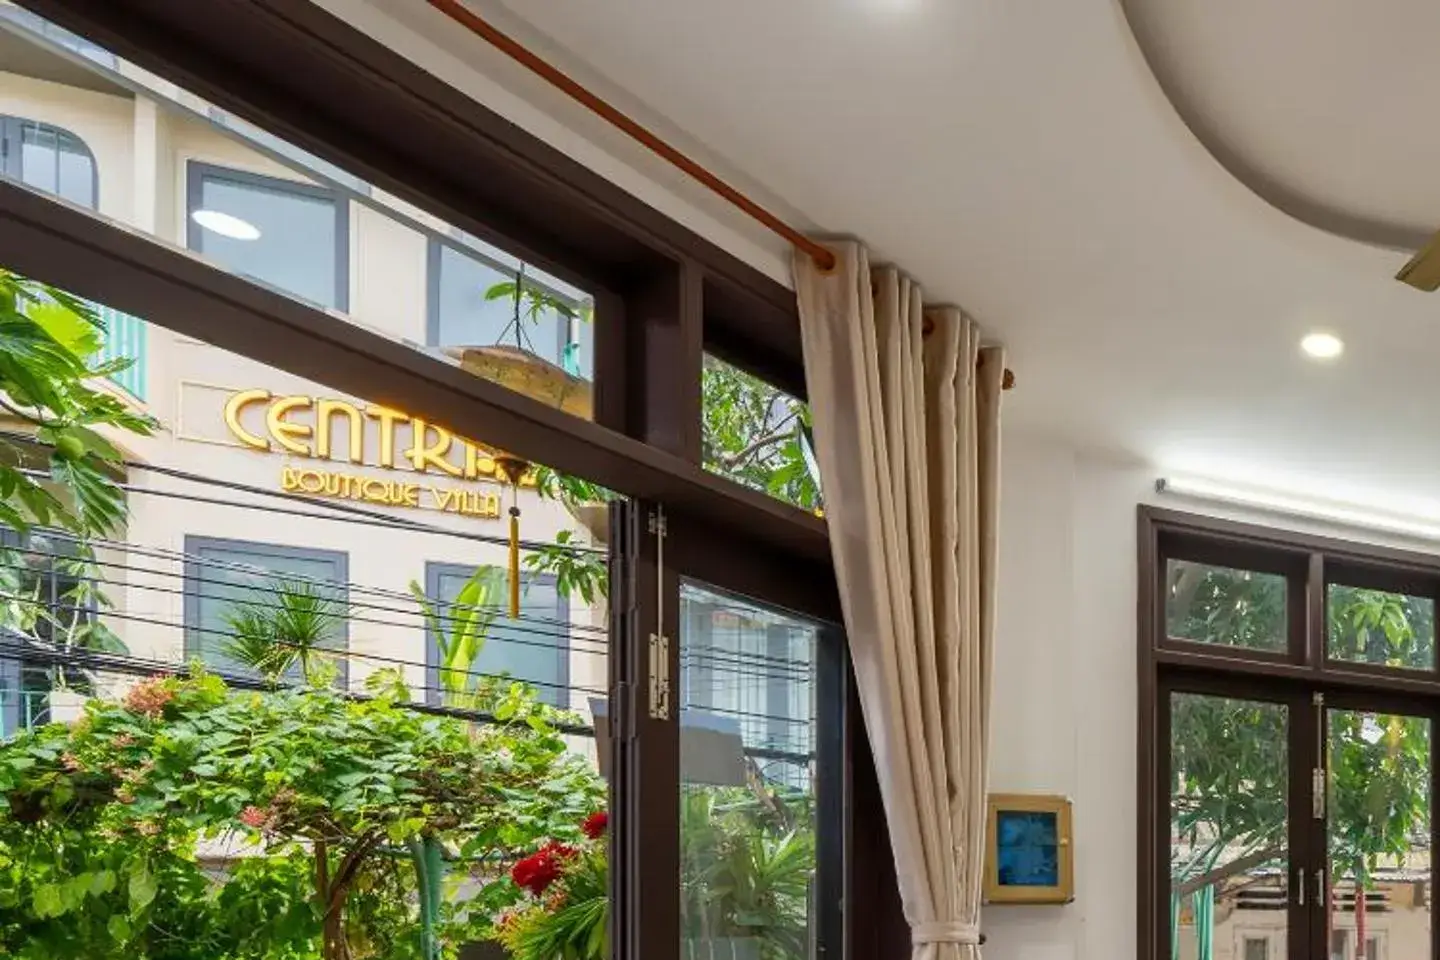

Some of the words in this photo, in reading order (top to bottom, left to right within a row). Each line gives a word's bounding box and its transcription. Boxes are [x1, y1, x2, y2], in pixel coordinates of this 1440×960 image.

[224, 388, 538, 488] CENTRA
[281, 466, 420, 506] BOUTIQUE
[432, 488, 500, 519] VILLA
